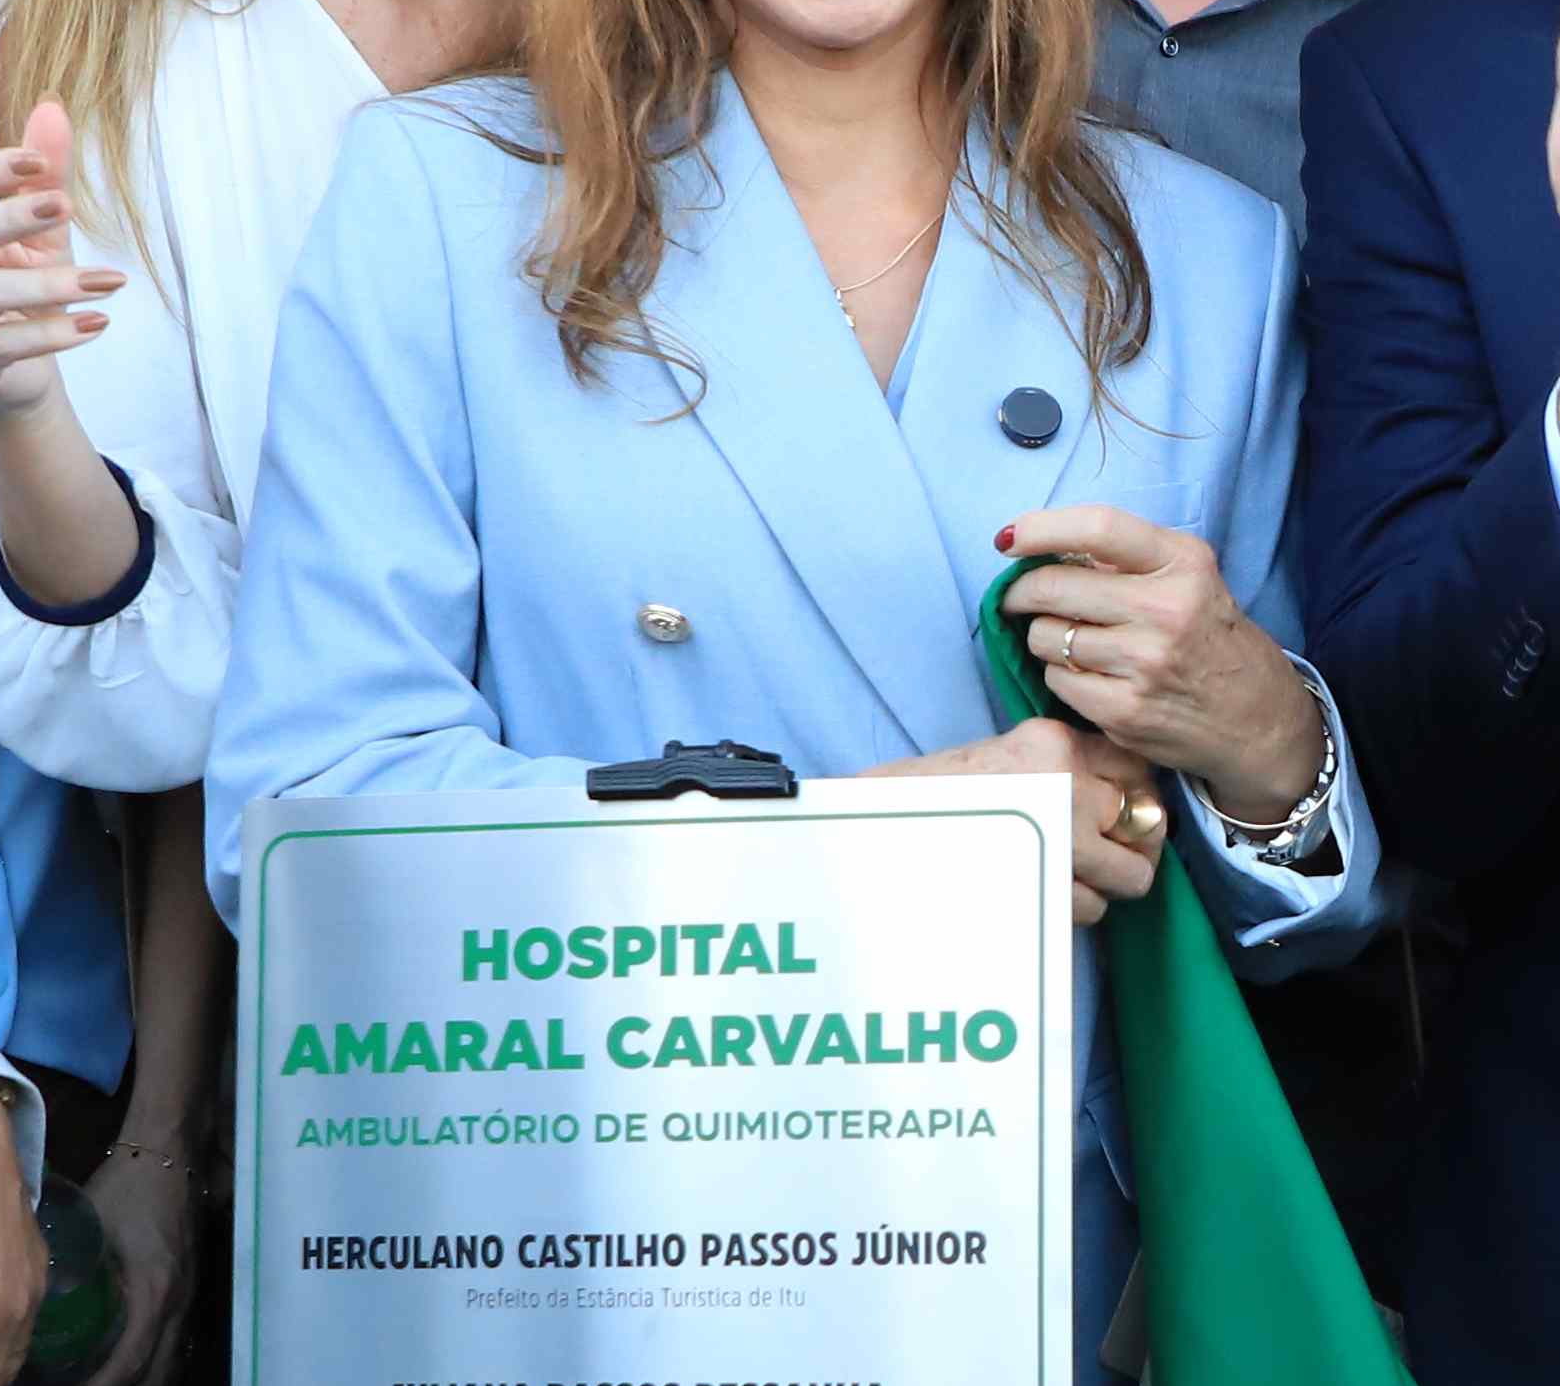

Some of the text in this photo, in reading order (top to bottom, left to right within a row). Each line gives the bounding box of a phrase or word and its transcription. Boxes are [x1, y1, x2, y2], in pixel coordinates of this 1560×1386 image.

[462, 921, 818, 983] HOSPITAL
[280, 1008, 1019, 1077] AMARAL CARVALHO
[295, 1107, 997, 1149] AMBULATÓRIO DE QUIMIOTERAPIA
[302, 1222, 988, 1271] HERCULANO CASTILHO PASSOS JÚNIOR
[465, 1286, 542, 1311] Prefeito
[545, 1286, 570, 1310] da
[575, 1286, 655, 1310] Estância
[746, 1285, 774, 1309] de
[778, 1286, 807, 1308] Itu
